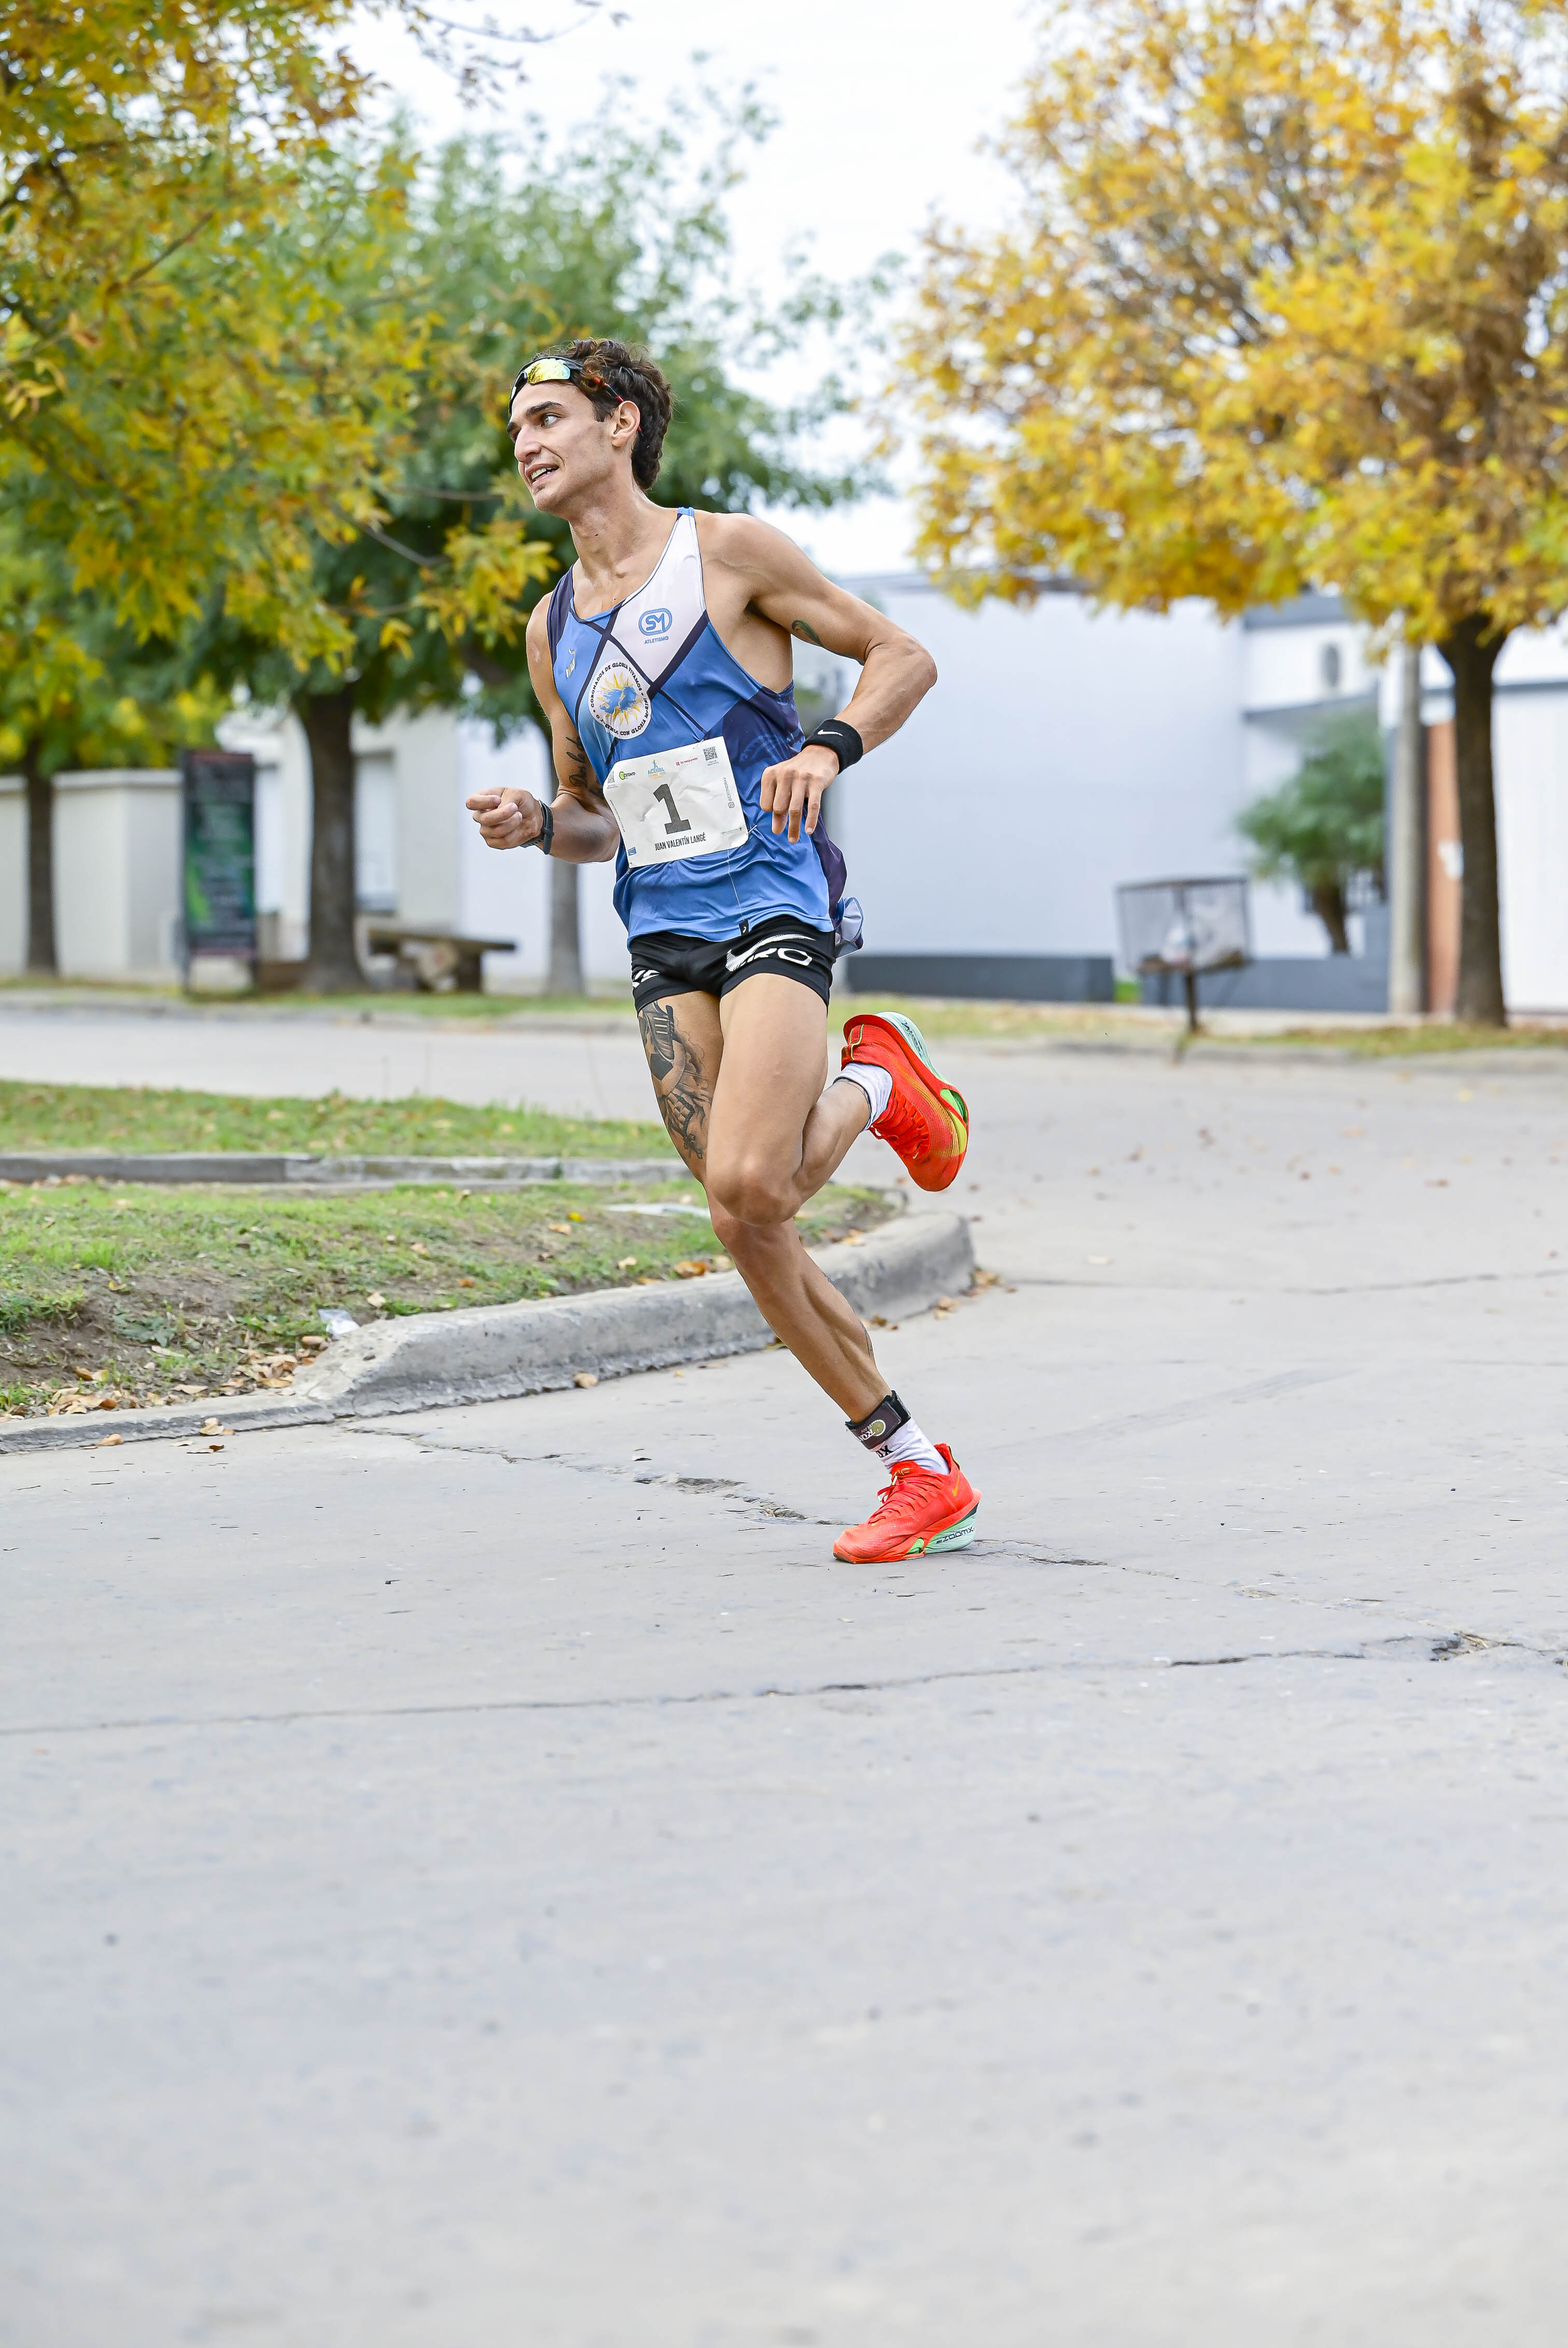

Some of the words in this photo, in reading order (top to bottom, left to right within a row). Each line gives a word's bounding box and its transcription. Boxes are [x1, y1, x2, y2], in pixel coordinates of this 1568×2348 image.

[646, 613, 665, 632] SM
[645, 636, 669, 644] ATLETISMO
[590, 669, 605, 708] CORONADOS
[628, 667, 642, 691] VIVAMOS
[631, 719, 646, 734] GLORIA
[653, 784, 692, 834] 1
[654, 842, 667, 850] JUAN
[666, 836, 690, 848] VALENTÍN
[691, 832, 706, 844] LANGÉ
